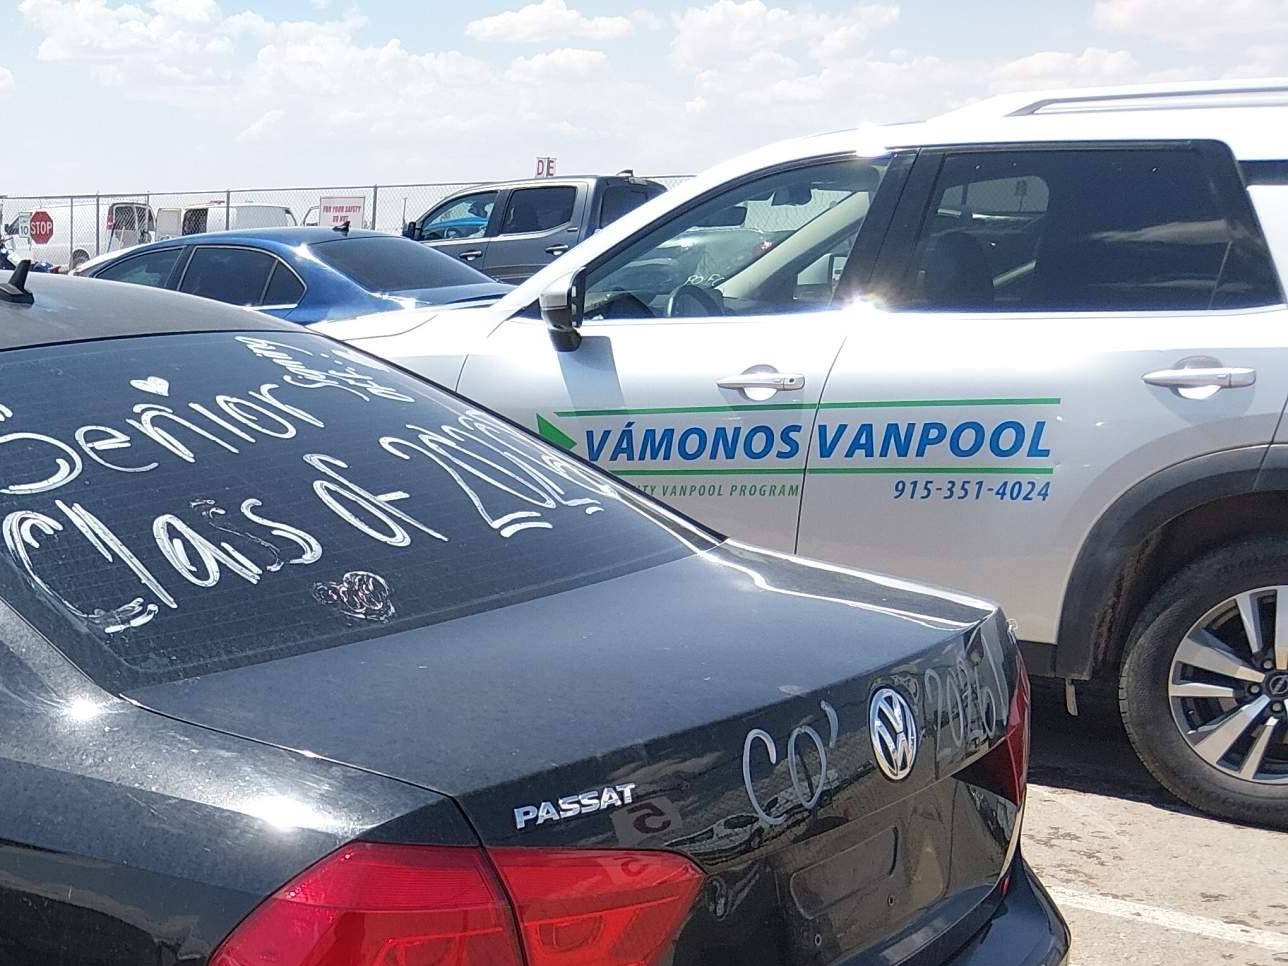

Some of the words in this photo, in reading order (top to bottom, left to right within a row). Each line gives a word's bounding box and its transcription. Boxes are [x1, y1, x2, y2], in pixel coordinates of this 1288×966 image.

[31, 221, 53, 234] STOP
[585, 421, 802, 462] VÁMONOS
[817, 420, 1051, 459] VANPOOL
[662, 484, 724, 497] VANPOOL
[730, 484, 800, 497] PROGRAM
[893, 479, 1052, 502] 915-351-4024
[513, 782, 636, 830] PASSAT
